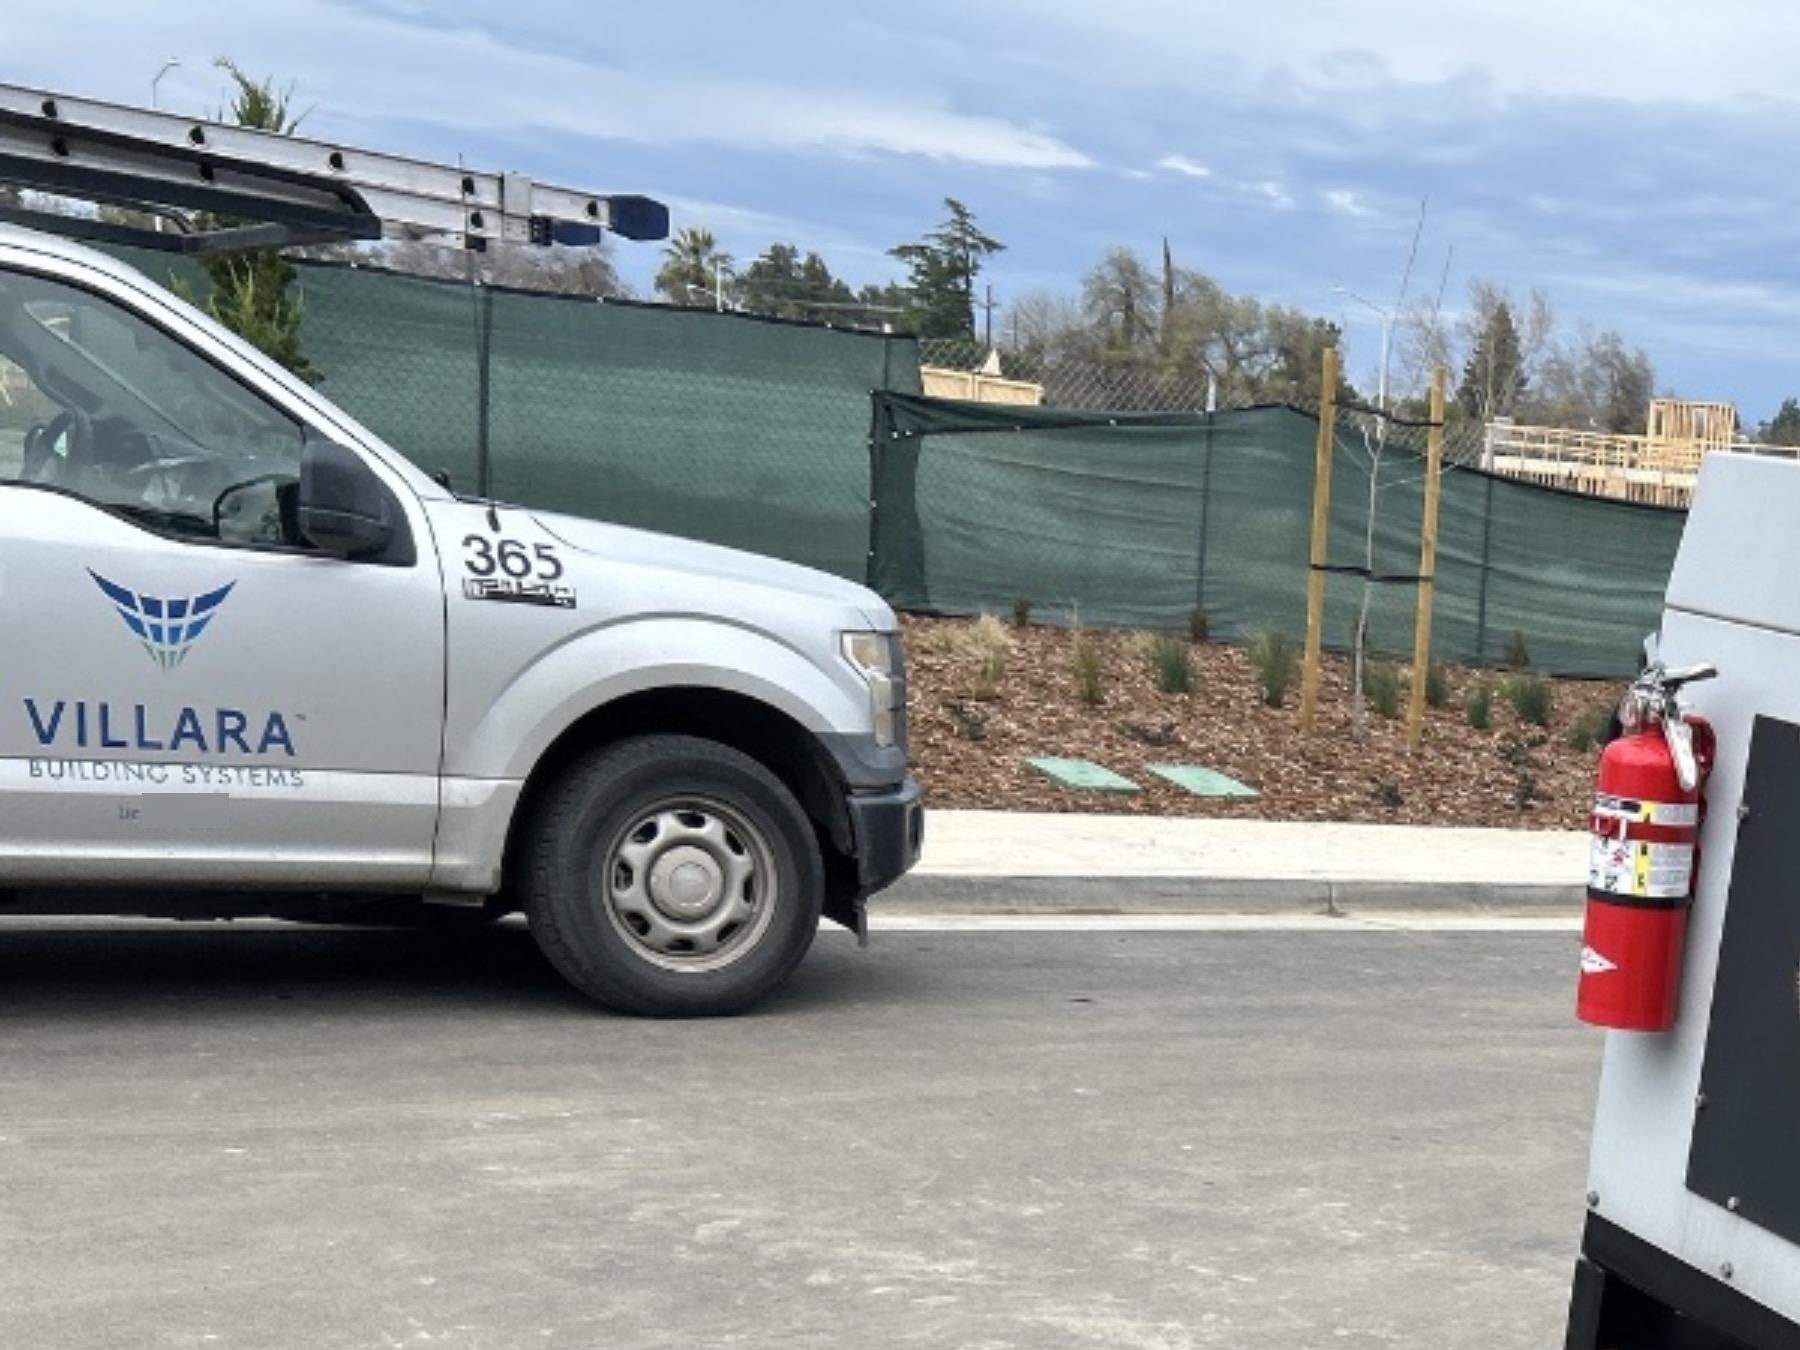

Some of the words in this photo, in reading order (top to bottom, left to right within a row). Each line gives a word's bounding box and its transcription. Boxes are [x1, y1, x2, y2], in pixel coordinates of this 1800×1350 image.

[462, 534, 563, 580] 365
[24, 698, 296, 757] VILLARA
[29, 758, 169, 784] BUILDING
[181, 763, 304, 788] SYSTEMS
